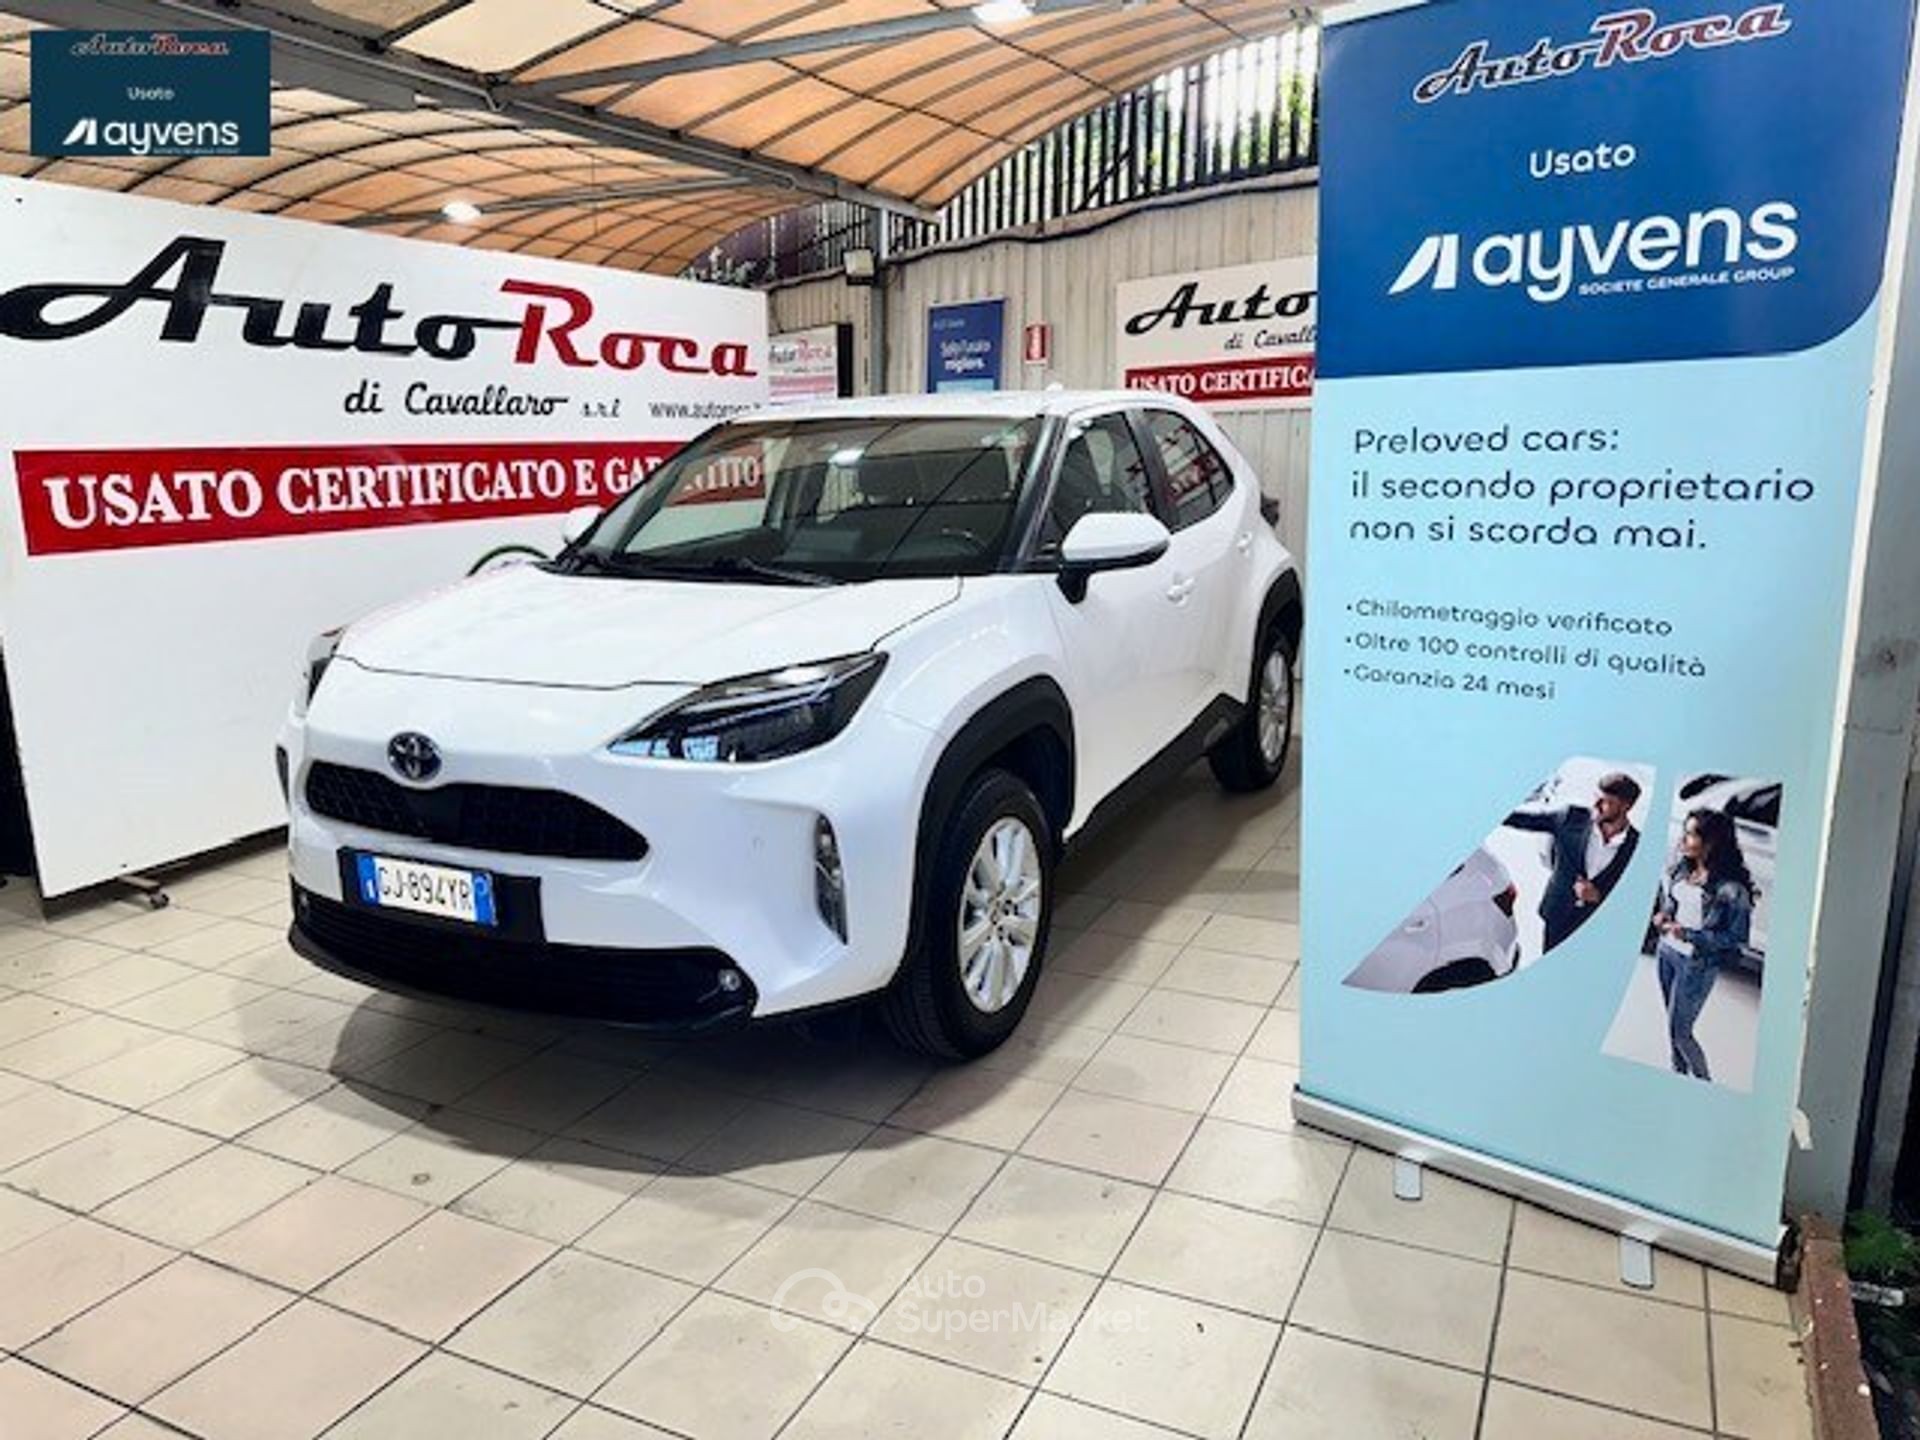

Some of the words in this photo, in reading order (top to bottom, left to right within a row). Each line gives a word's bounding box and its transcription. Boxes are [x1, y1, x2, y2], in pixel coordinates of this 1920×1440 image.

[1529, 141, 1636, 178] Usato
[1473, 202, 1799, 302] ayvens
[1647, 270, 1729, 290] GENERALE
[1734, 266, 1795, 282] GROUP
[1201, 364, 1315, 393] CERTIFIC
[344, 379, 383, 413] di
[405, 381, 569, 416] Cavallaro
[1355, 424, 1509, 453] Preloved
[1522, 429, 1618, 452] cars:
[42, 469, 263, 529] USATO
[276, 459, 565, 515] CERTIFICATO
[573, 459, 597, 495] E
[1352, 469, 1369, 498] il
[1382, 469, 1535, 499] secondo
[1549, 468, 1814, 508] proprietario
[1350, 521, 1415, 540] non
[1428, 515, 1454, 541] si
[1469, 516, 1597, 545] scorda
[1614, 518, 1706, 548] mai.
[1355, 599, 1538, 631] Chilometraggio
[1547, 612, 1672, 637] verificato
[1355, 632, 1410, 652] Oltre
[1419, 635, 1459, 656] 100
[1465, 639, 1567, 665] controlli
[1575, 648, 1599, 668] di
[1608, 653, 1706, 679] qualità
[1353, 664, 1455, 689] Garanzia
[1462, 673, 1489, 692] 24
[1496, 679, 1556, 700] mesi
